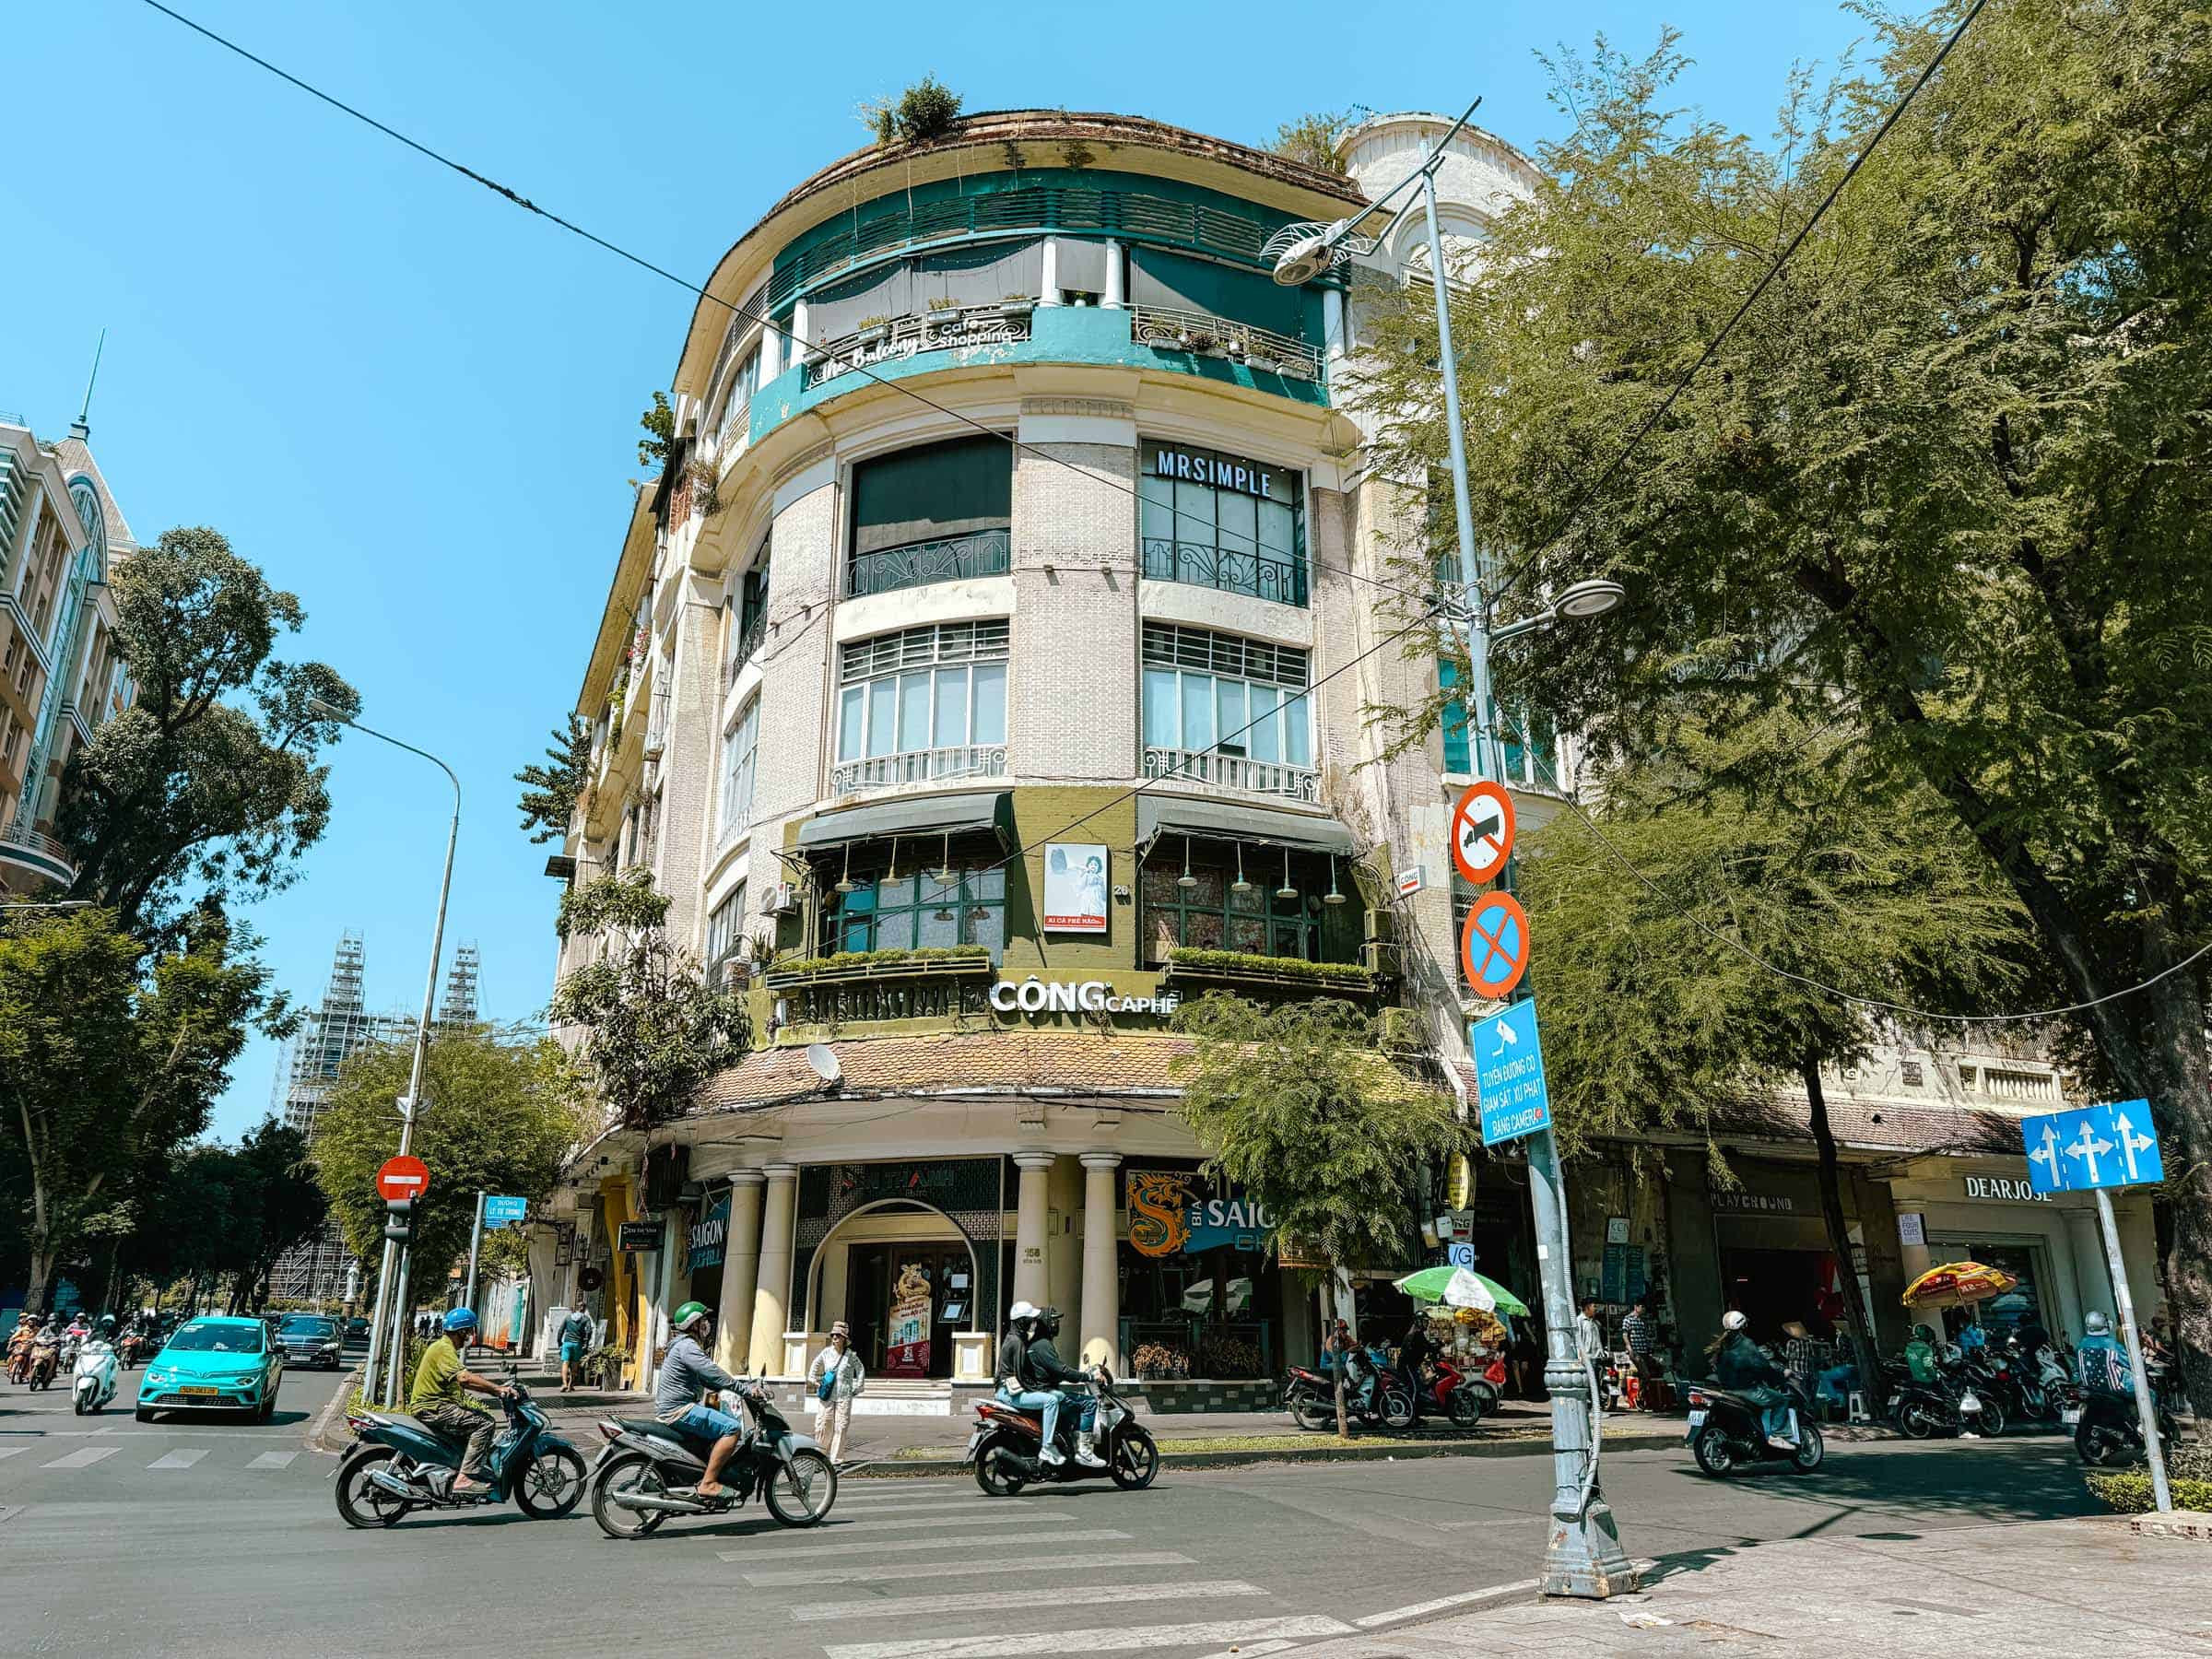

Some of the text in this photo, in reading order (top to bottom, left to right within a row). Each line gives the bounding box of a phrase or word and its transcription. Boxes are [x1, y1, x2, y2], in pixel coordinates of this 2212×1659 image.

[1158, 450, 1271, 498] MRSIMPLE
[990, 974, 1105, 1018] CỘNG
[1192, 1199, 1277, 1229] BIA SAIG
[692, 1218, 724, 1249] SAIGON
